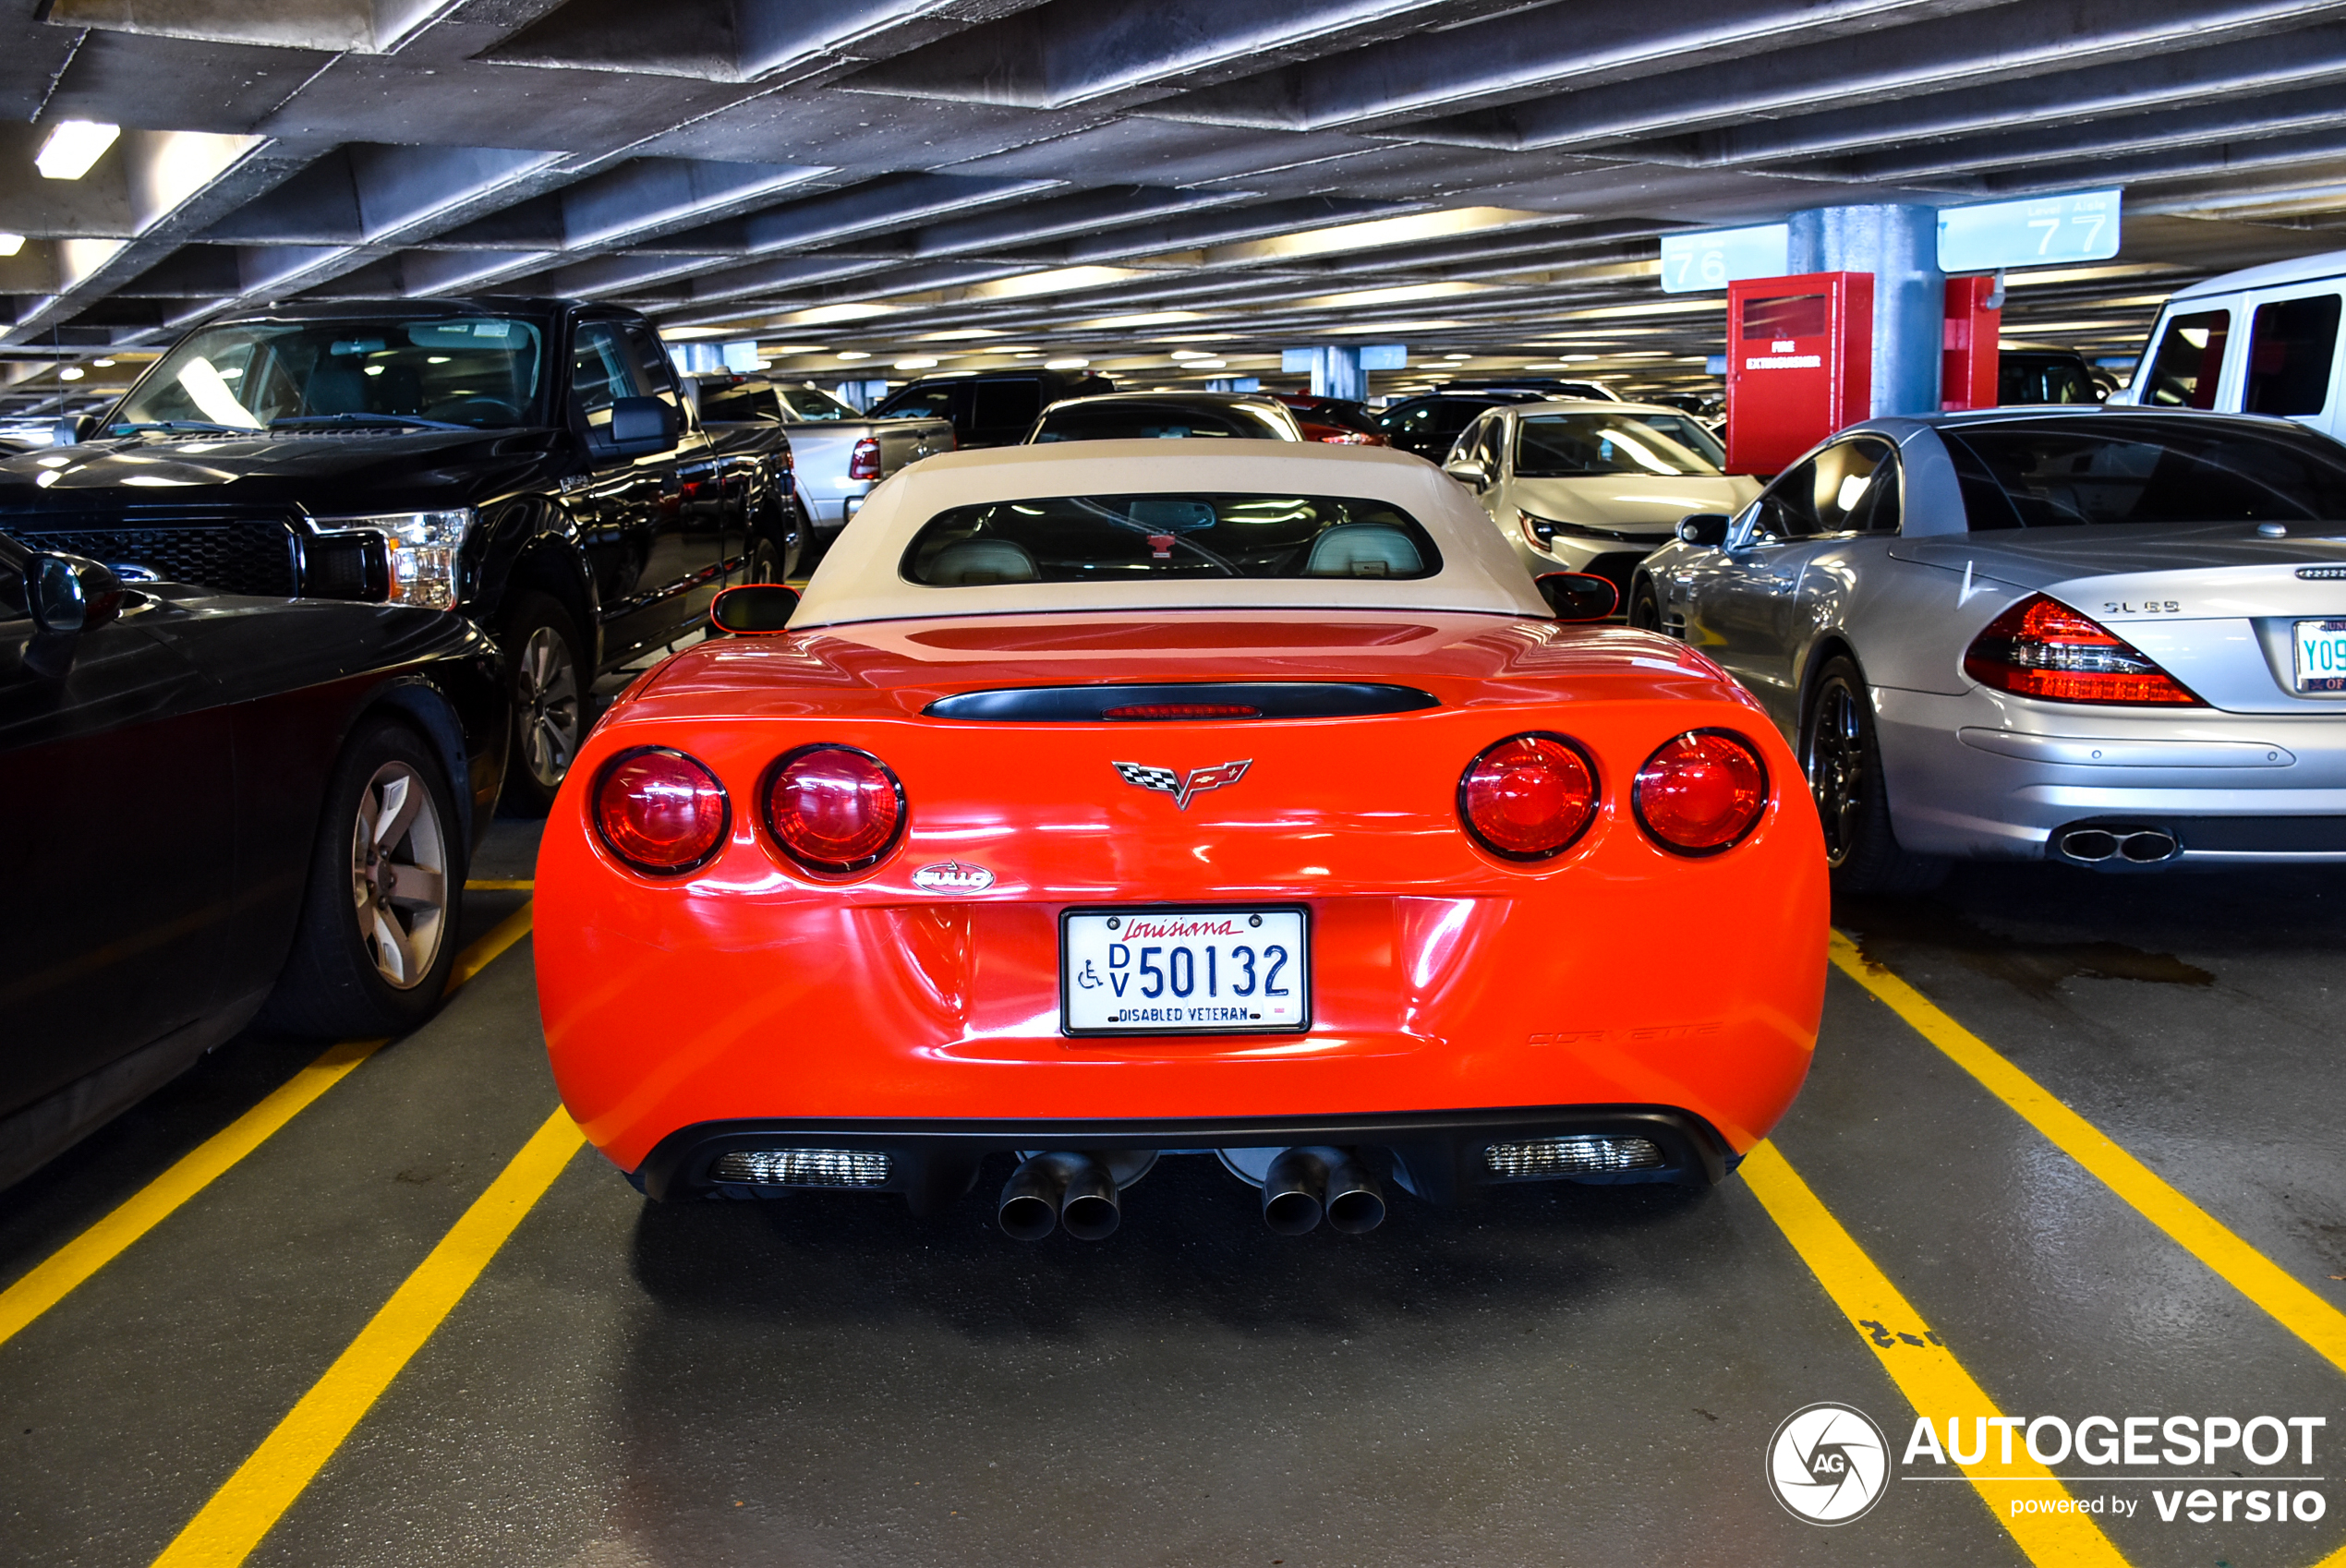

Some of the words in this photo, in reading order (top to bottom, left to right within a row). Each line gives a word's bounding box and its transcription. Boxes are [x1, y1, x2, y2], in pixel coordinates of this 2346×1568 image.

[2028, 204, 2062, 216] Level
[2073, 200, 2107, 212] Aisle
[1772, 340, 1796, 354] FIRE
[1746, 356, 1821, 370] EXTINGUISHER
[2328, 621, 2346, 631] UN
[2326, 679, 2345, 691] OF
[1121, 916, 1244, 942] Louisiana
[1119, 1007, 1183, 1022] DISABLED
[1188, 1007, 1249, 1021] VETERAN
